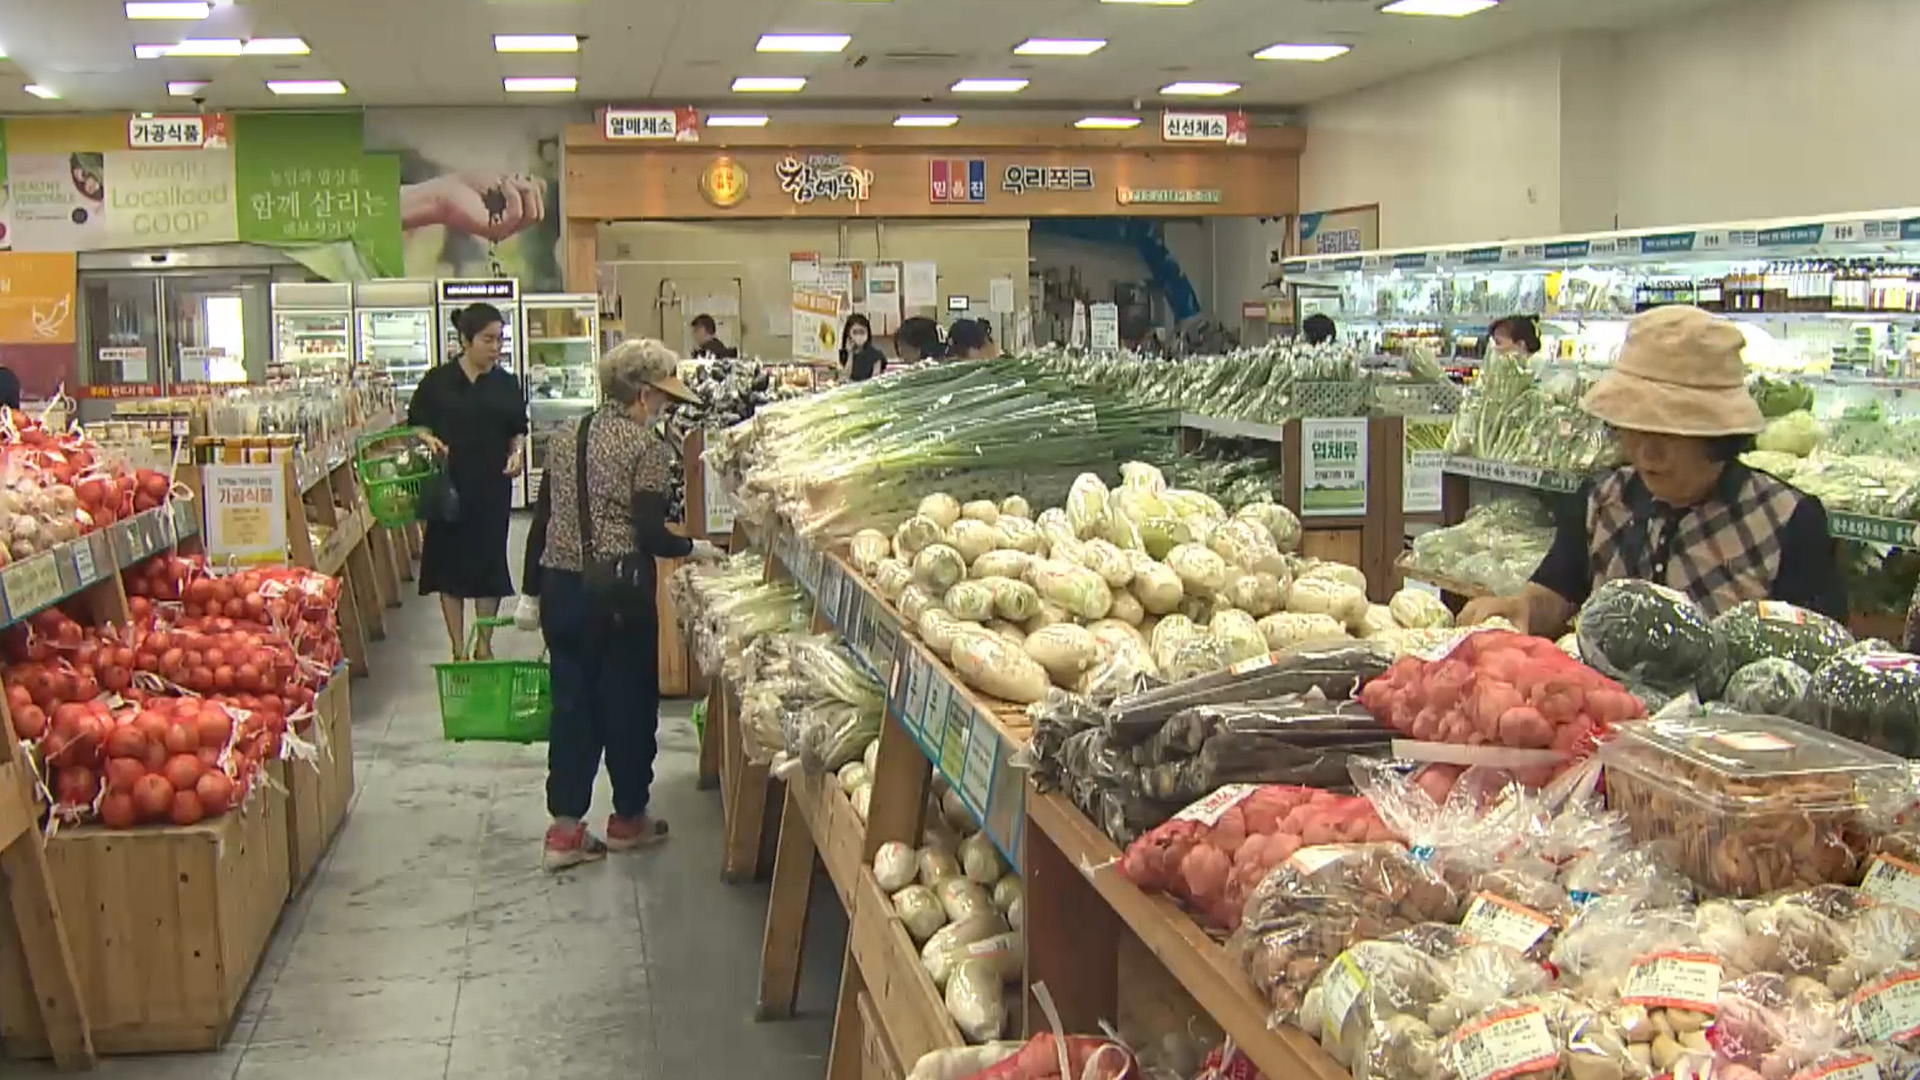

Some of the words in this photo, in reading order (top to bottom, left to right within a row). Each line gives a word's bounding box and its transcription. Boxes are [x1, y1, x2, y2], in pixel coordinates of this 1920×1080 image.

[133, 124, 200, 143] 가공식품
[610, 117, 673, 135] 열매채소
[1167, 118, 1224, 136] 신선채소
[131, 161, 207, 182] Wanju
[252, 191, 300, 220] 함께
[310, 189, 388, 218] 살리는
[133, 211, 210, 234] COOP
